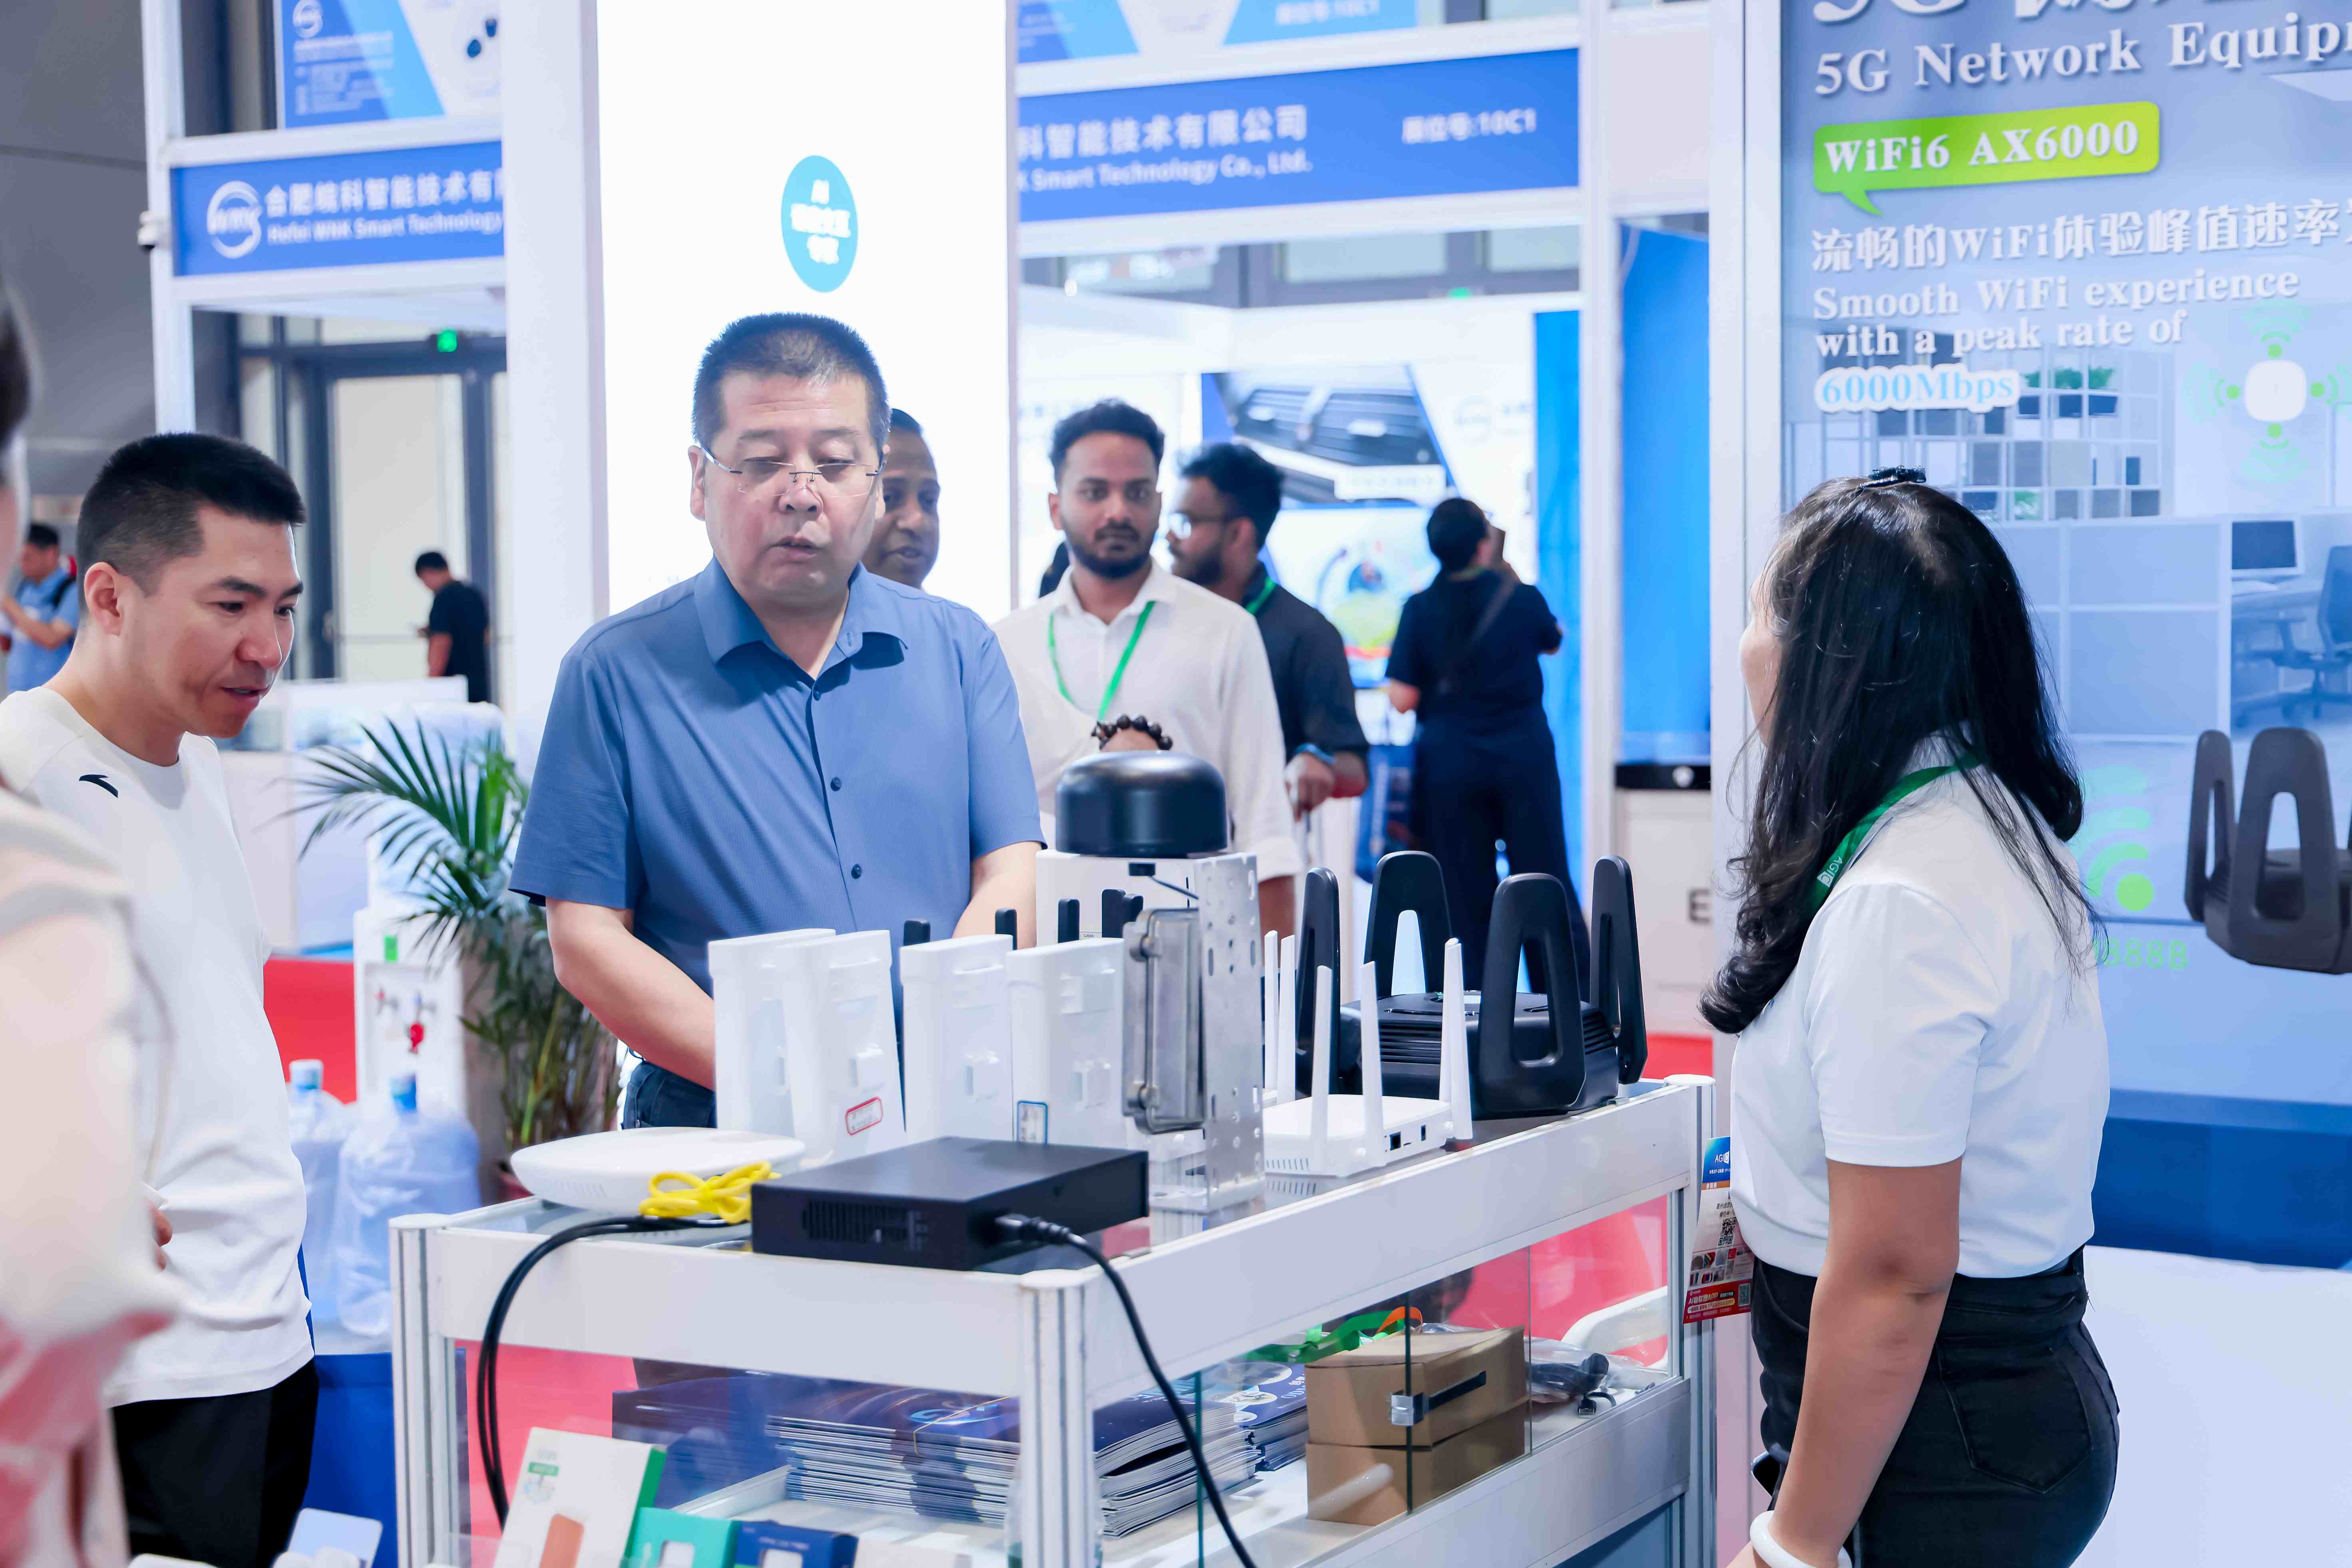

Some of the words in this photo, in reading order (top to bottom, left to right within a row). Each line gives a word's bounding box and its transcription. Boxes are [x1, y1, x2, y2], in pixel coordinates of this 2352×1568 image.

[1815, 49, 1889, 94] 5G
[1914, 29, 2142, 86] Network
[1824, 135, 1950, 173] WiFi6
[1968, 121, 2139, 167] AX6000
[1812, 198, 2352, 272] 流畅的WiFi体验峰值速率
[1813, 282, 1960, 320] Smooth
[1978, 275, 2068, 310] WiFi
[2085, 268, 2300, 309] experience
[1816, 323, 1899, 357] with
[1914, 329, 1937, 354] a
[1952, 317, 2041, 358] peak
[2057, 314, 2134, 347] rate
[2149, 309, 2188, 343] of
[1822, 371, 2014, 404] 6000Mbps
